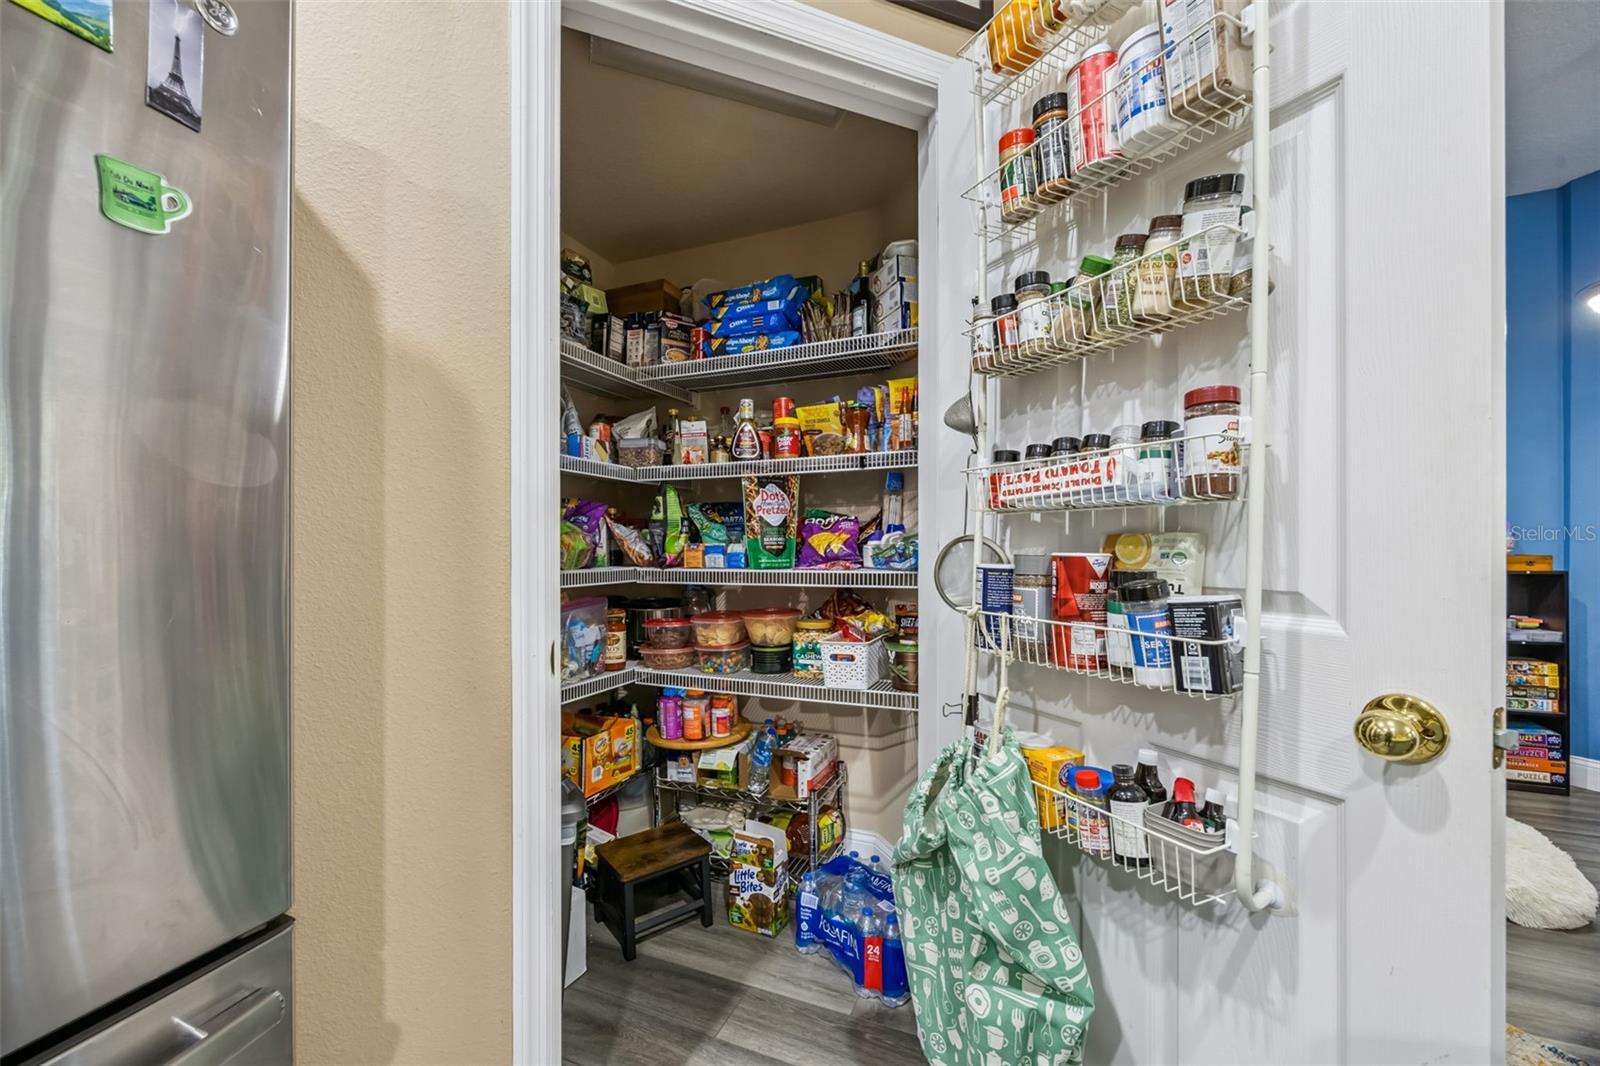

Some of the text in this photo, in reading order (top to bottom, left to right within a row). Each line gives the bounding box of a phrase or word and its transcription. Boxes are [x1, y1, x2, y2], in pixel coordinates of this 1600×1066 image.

[1045, 460, 1101, 479] TOMATO
[1065, 477, 1103, 489] DOUBLE
[761, 489, 786, 502] Dot's
[756, 505, 789, 515] Pretzels
[796, 652, 821, 660] CASHEW
[1517, 772, 1548, 781] PUZZLE
[734, 868, 755, 884] Little
[740, 880, 763, 894] Bites
[866, 944, 881, 956] 24
